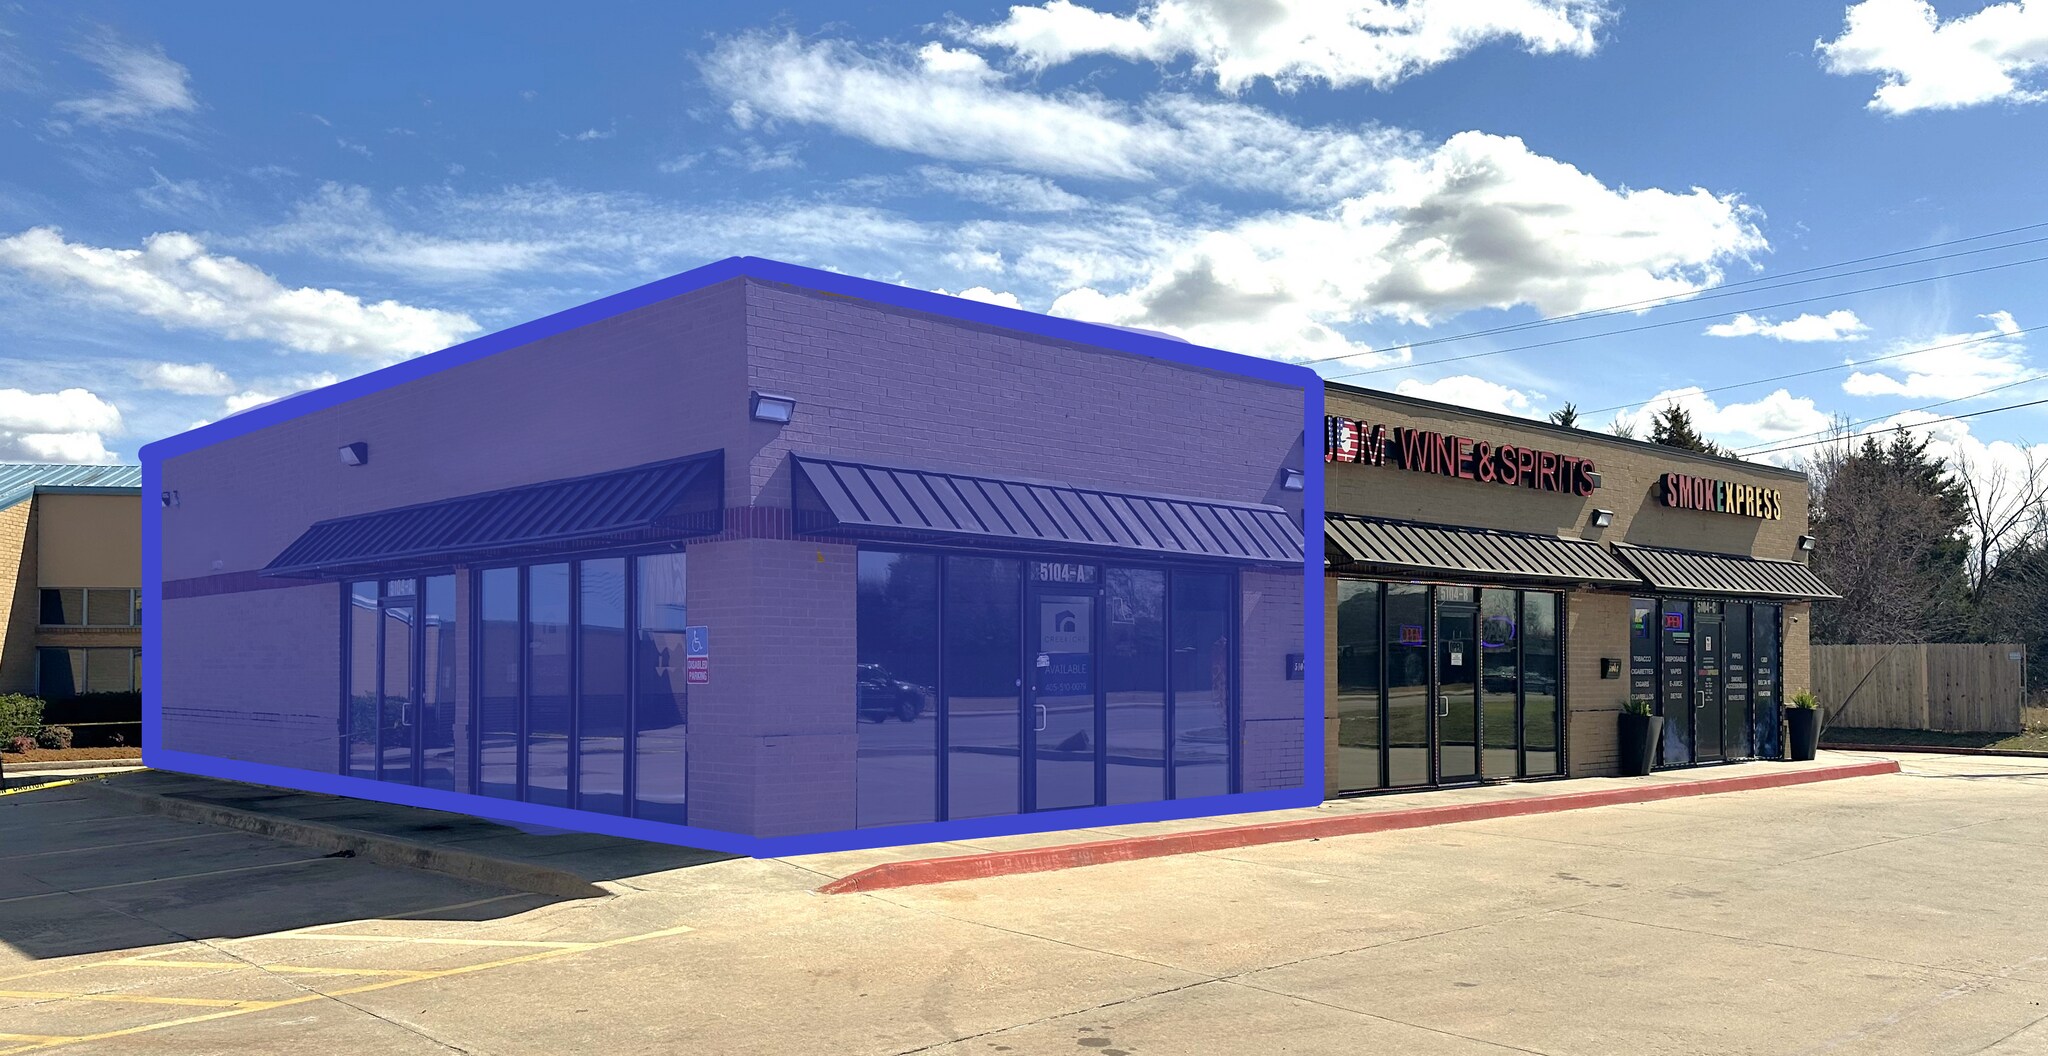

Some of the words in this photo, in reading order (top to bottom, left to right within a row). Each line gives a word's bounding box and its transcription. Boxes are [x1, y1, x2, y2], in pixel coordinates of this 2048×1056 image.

[1325, 415, 1386, 467] JDM
[1663, 472, 1782, 521] SMOKEXPRESS
[1040, 563, 1085, 583] 5104-A
[1440, 587, 1469, 601] 5104-B
[1697, 601, 1716, 613] 5104-C
[688, 661, 708, 670] DISABLED
[1045, 663, 1087, 674] AVAILABLE
[689, 671, 708, 681] PARKING
